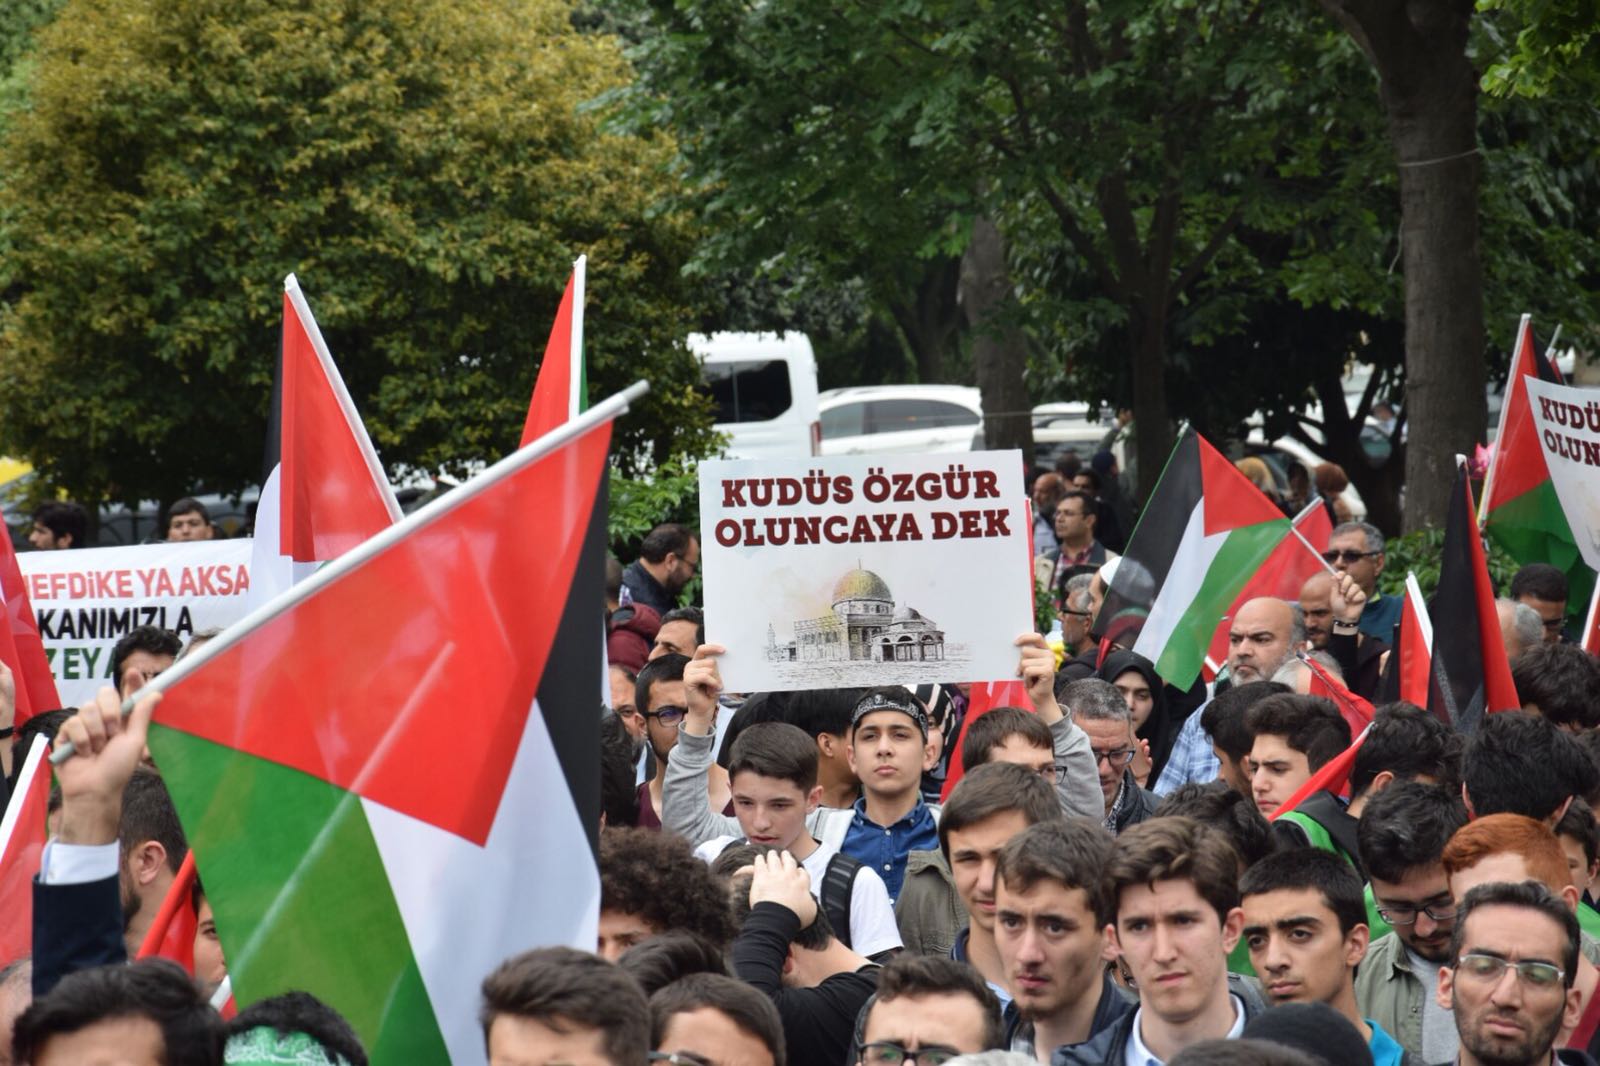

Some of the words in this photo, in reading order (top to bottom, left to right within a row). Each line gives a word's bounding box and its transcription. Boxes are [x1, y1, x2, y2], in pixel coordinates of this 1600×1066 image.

[722, 469, 854, 508] KUDÜS
[862, 464, 1001, 502] ÖZGÜR
[715, 513, 923, 548] OLUNCAYA
[931, 508, 1011, 540] DEK
[38, 606, 194, 640] KANIMIZLA
